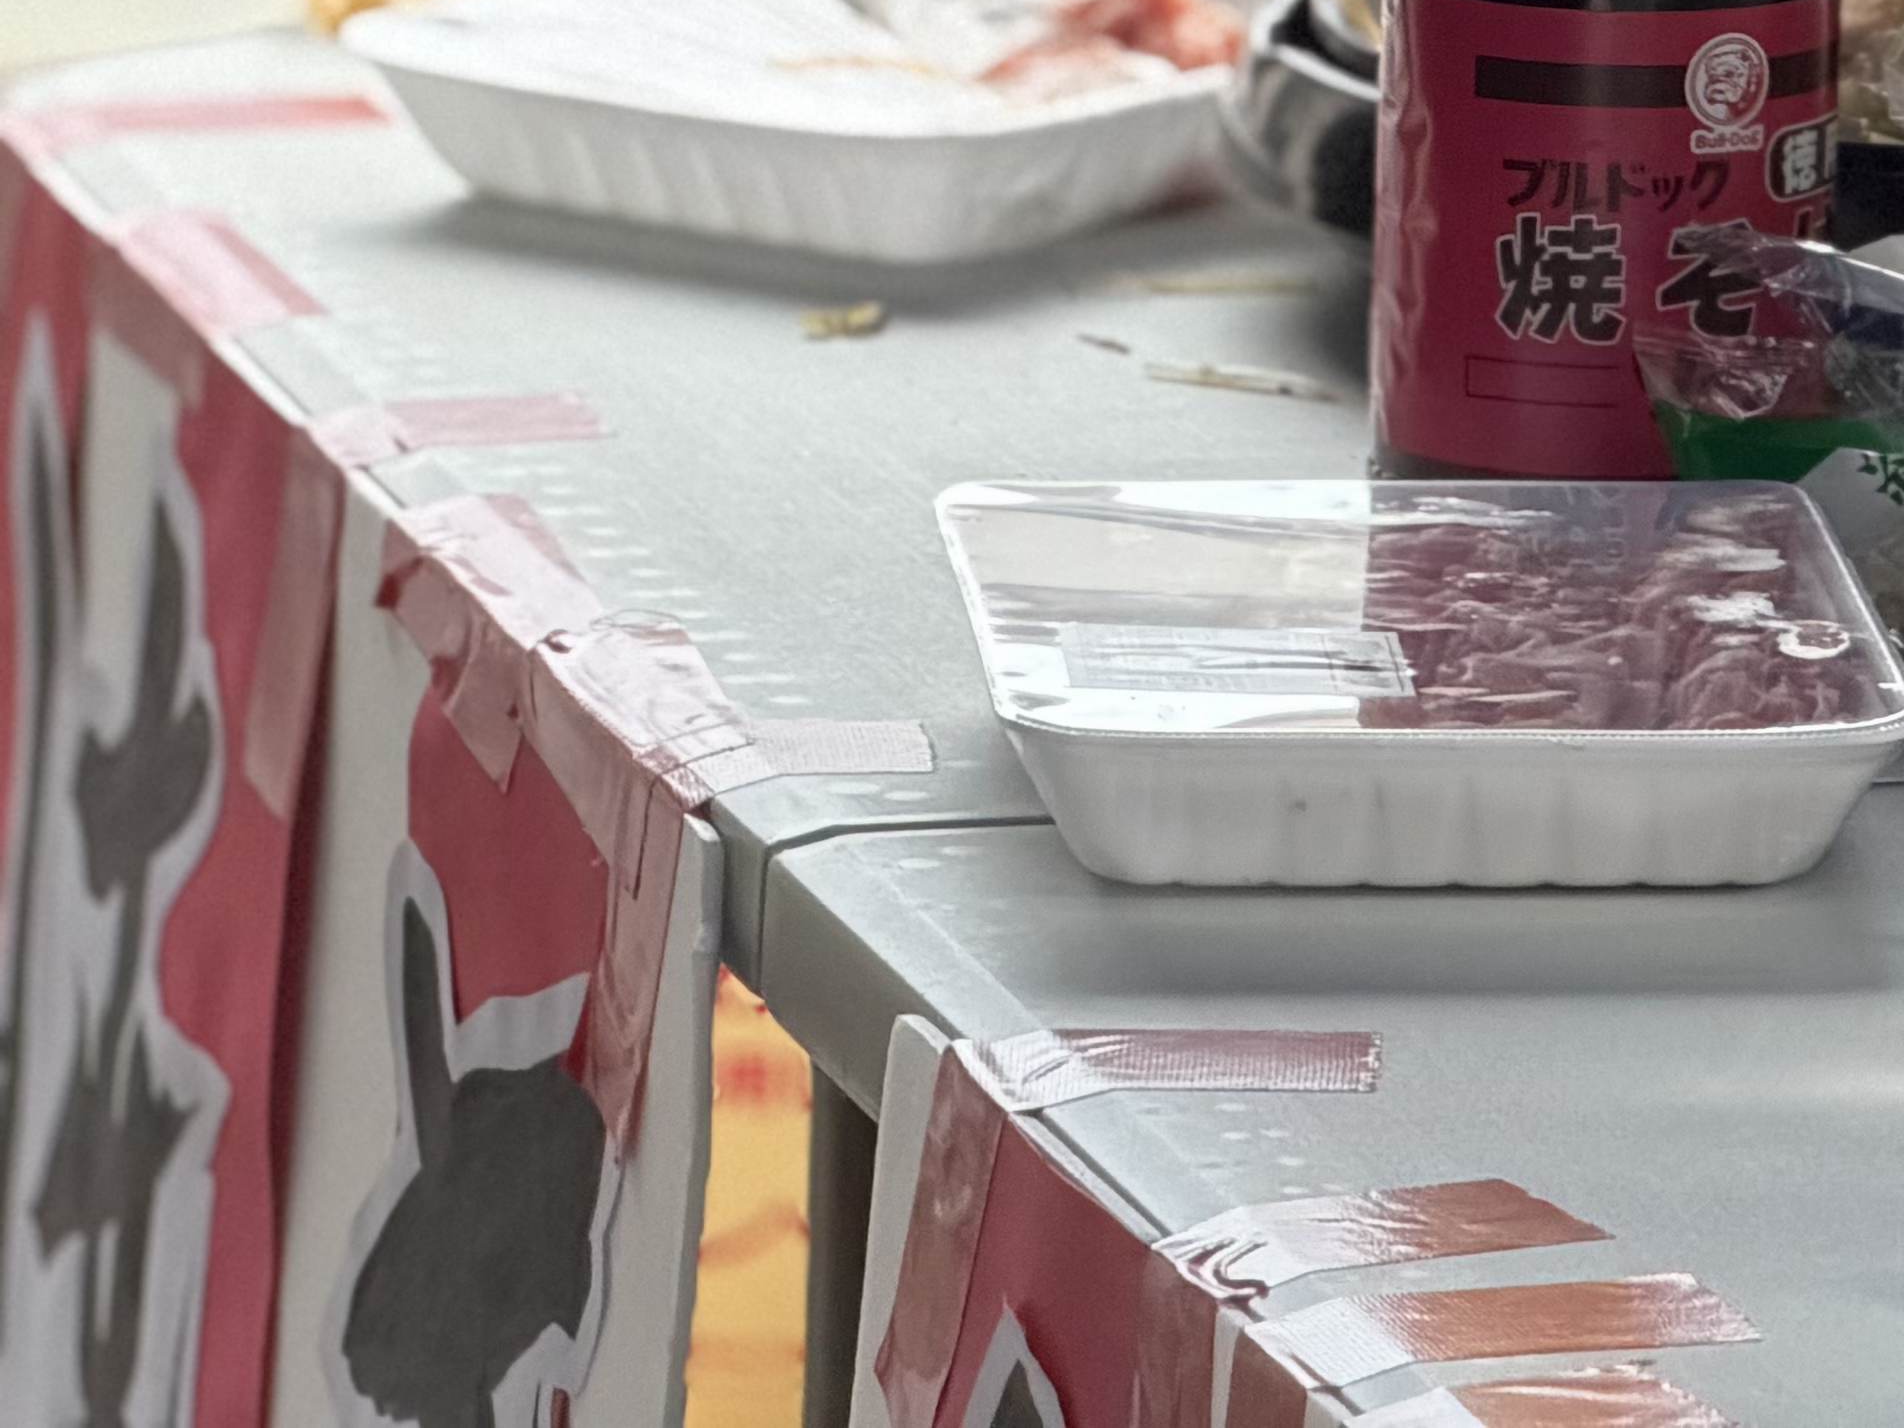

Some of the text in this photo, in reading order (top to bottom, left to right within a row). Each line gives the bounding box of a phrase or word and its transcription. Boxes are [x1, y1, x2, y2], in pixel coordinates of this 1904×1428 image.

[1503, 159, 1730, 213] ブルドック
[1497, 213, 1764, 344] 焼そ
